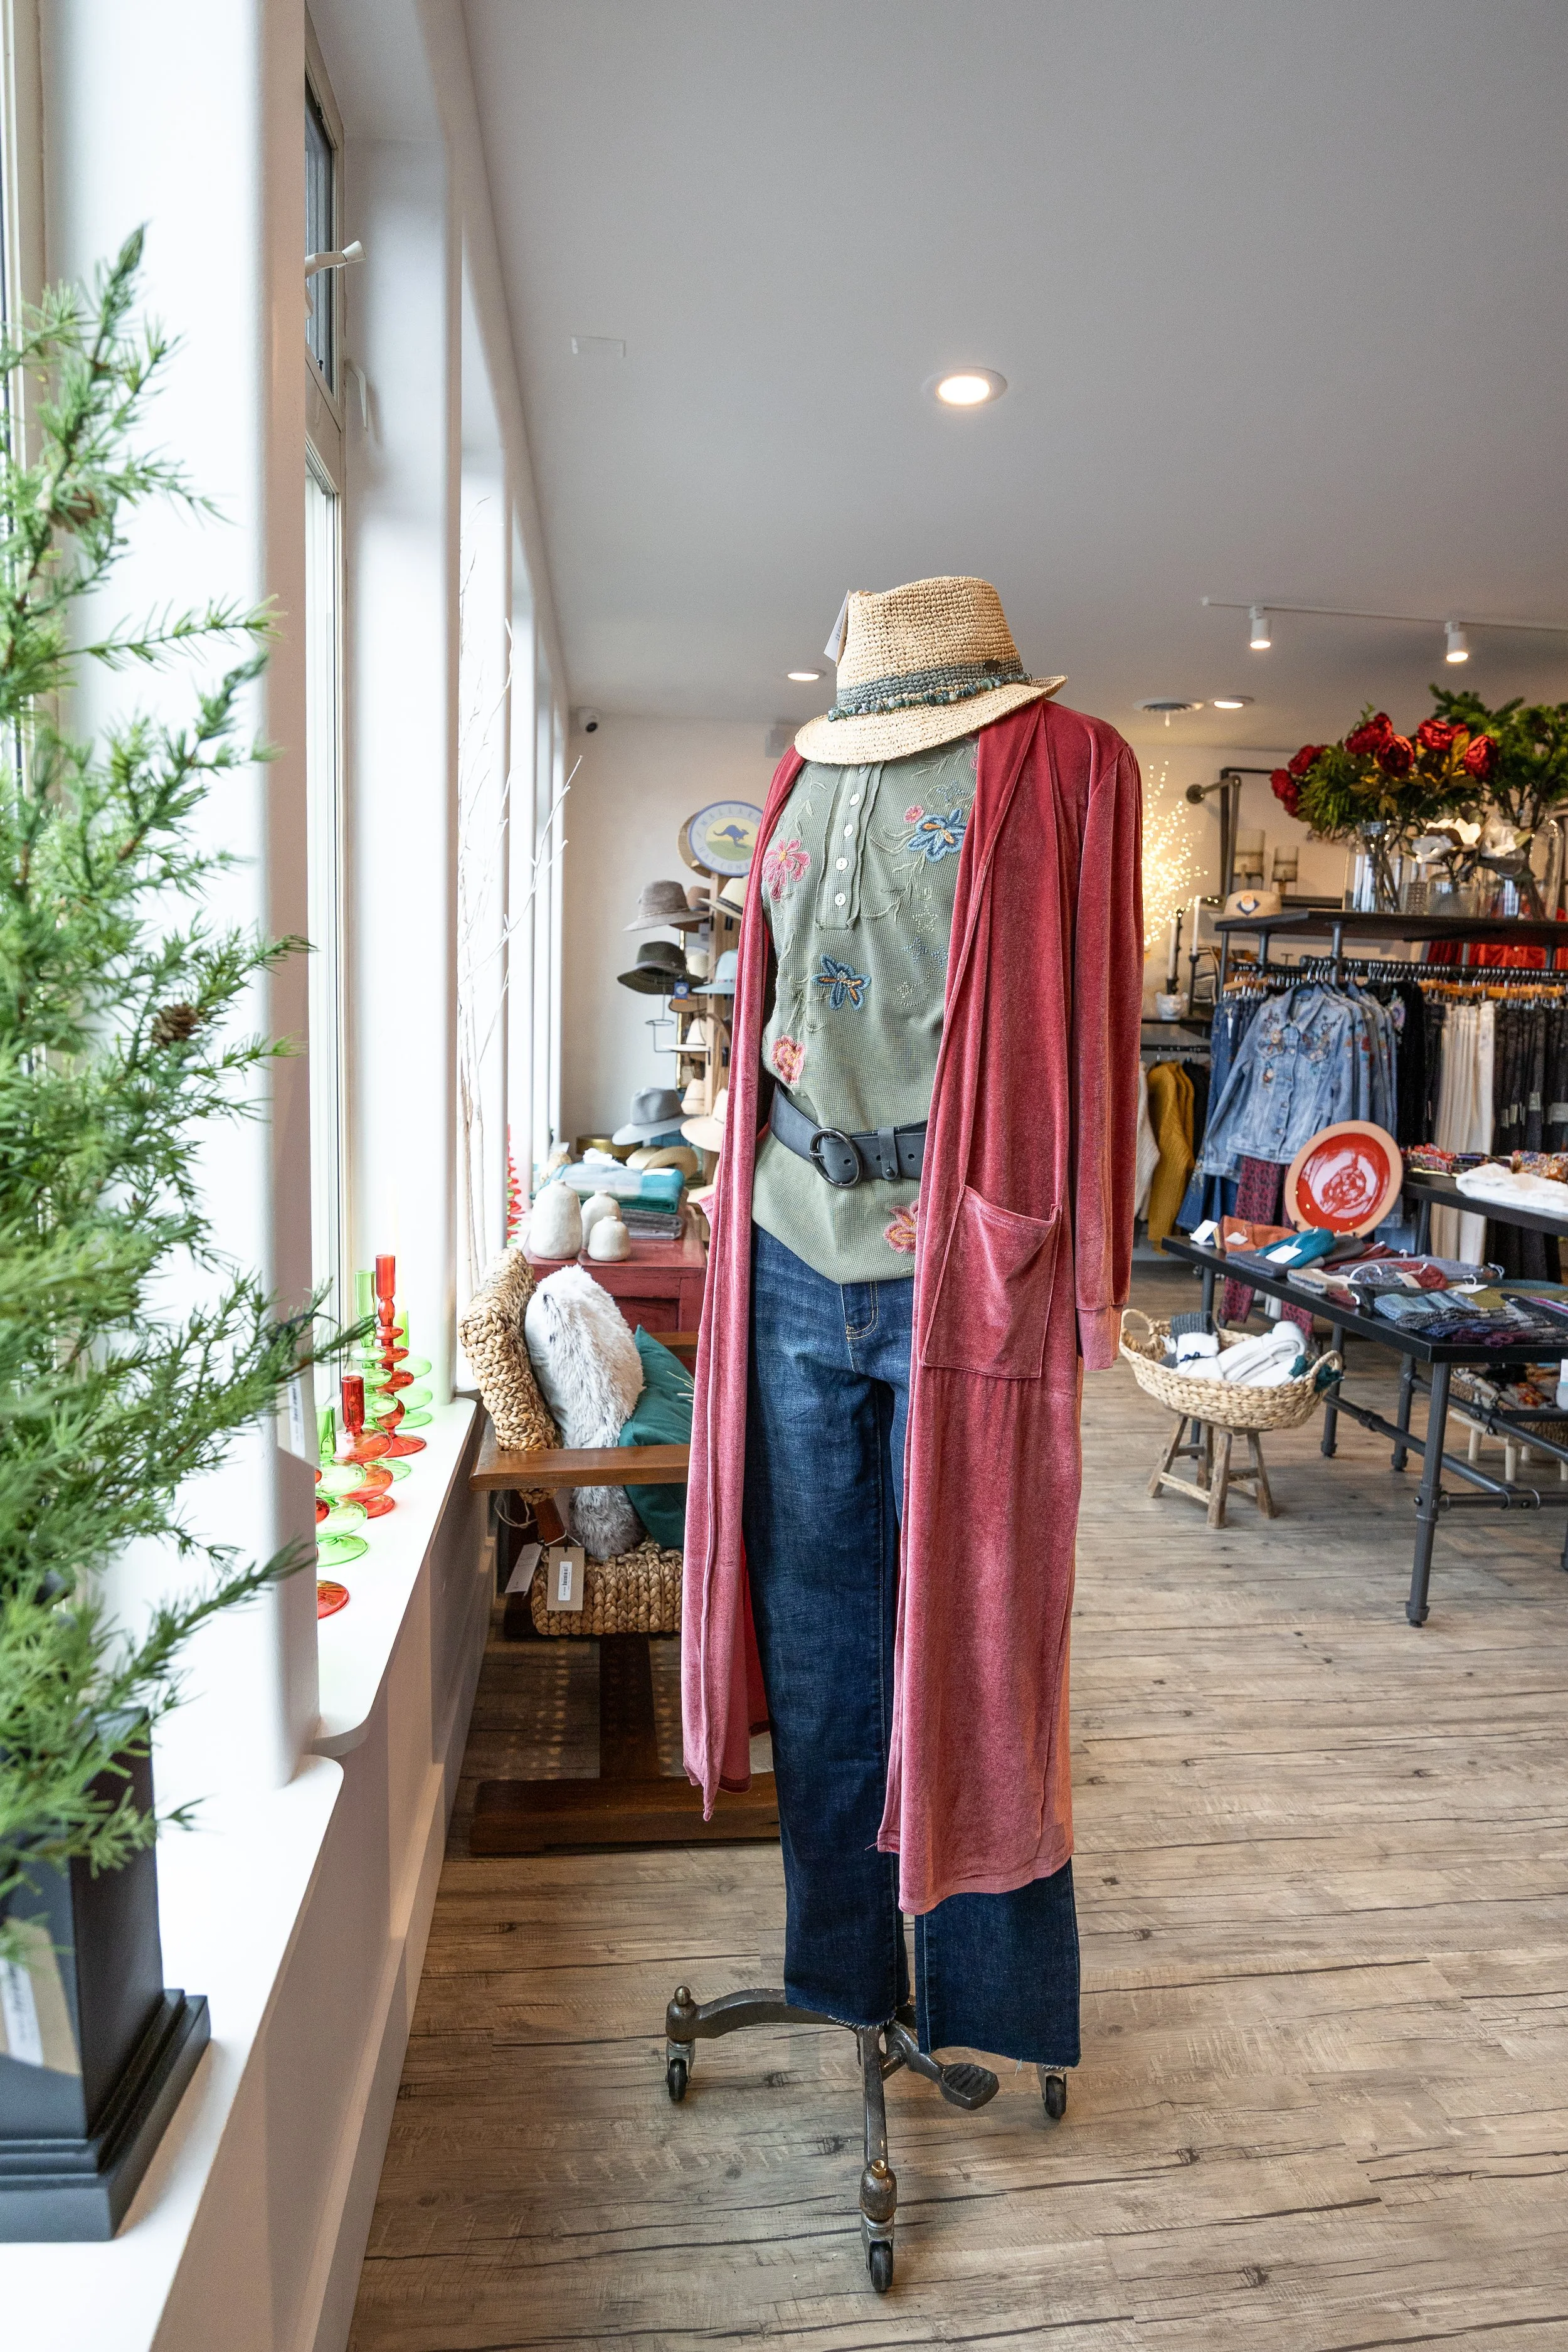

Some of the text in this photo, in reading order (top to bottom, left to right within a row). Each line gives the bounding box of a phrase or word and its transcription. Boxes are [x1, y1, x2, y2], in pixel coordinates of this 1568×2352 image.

[700, 806, 761, 826] WALLARO
[698, 846, 750, 872] HAT COMP
